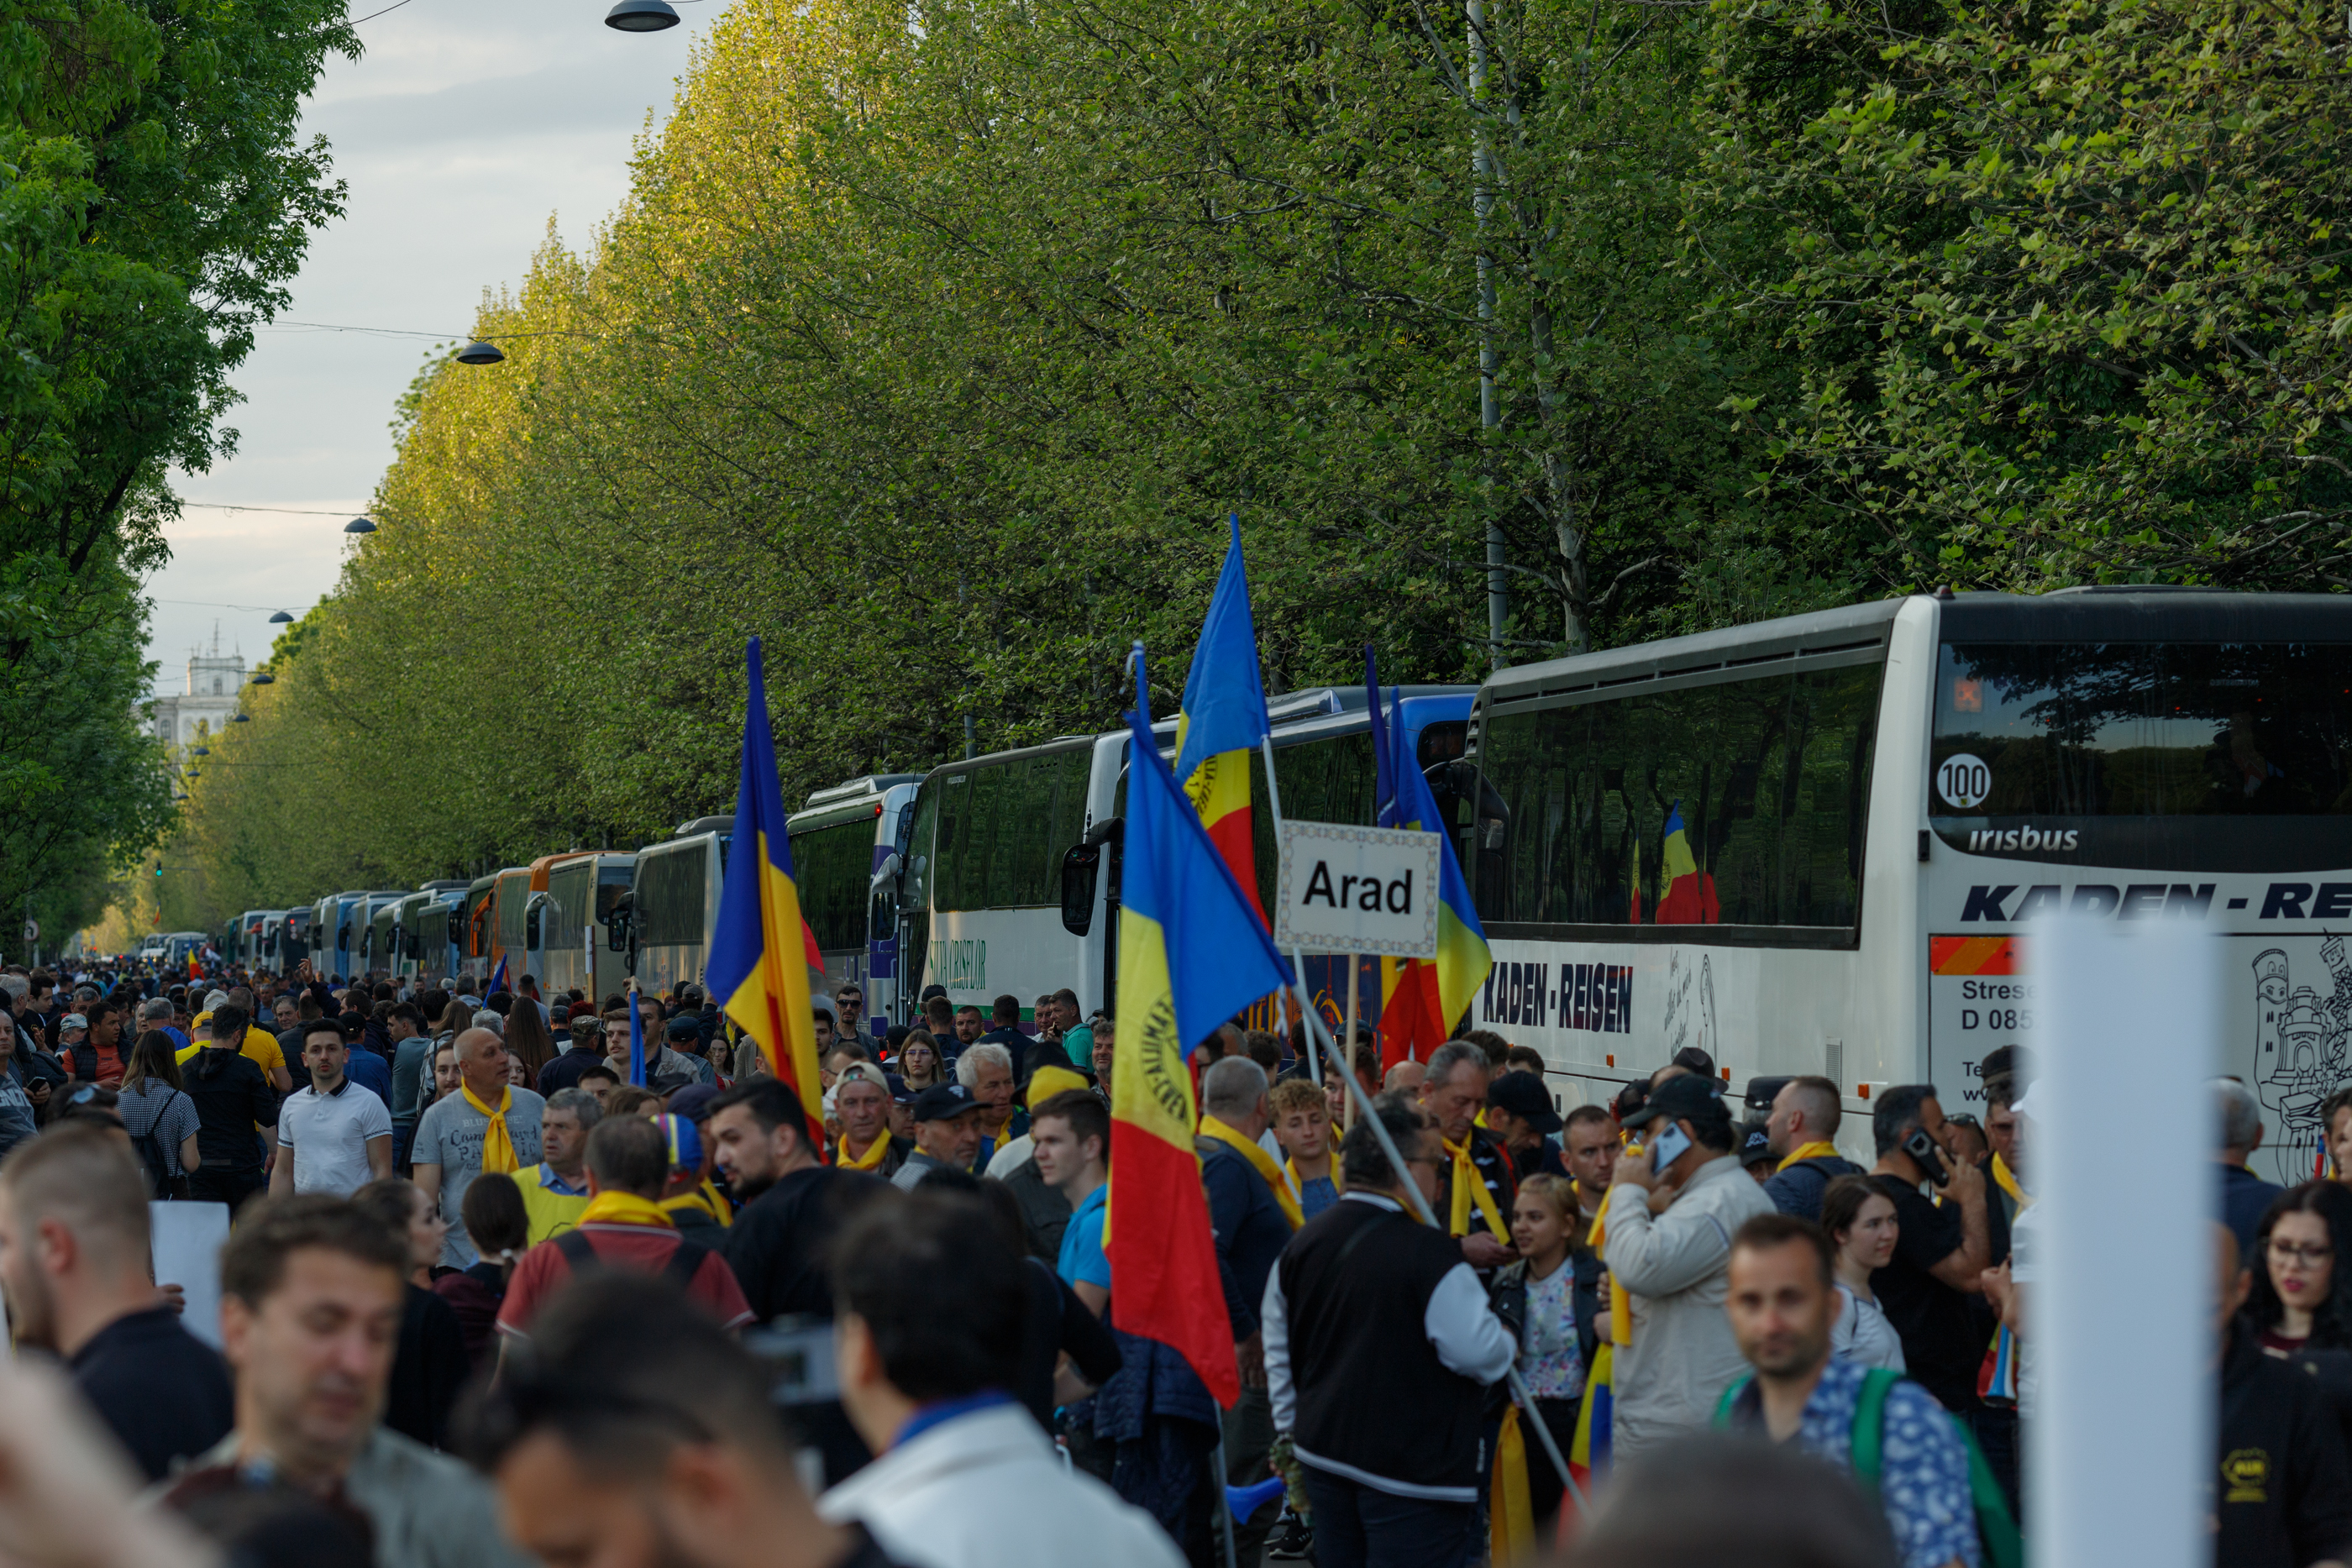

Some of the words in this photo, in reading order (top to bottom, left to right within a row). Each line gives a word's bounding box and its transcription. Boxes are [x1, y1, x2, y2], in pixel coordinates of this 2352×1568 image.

[1943, 763, 1986, 799] 100
[1968, 825, 2079, 852] irisbus
[1302, 860, 1413, 915] Arad
[929, 939, 948, 989] SILVA
[949, 938, 986, 991] CRISFLOR
[1962, 980, 2038, 999] Strese
[1962, 1009, 1980, 1030] D
[1988, 1009, 2036, 1030] 085
[1962, 1062, 1982, 1078] Te
